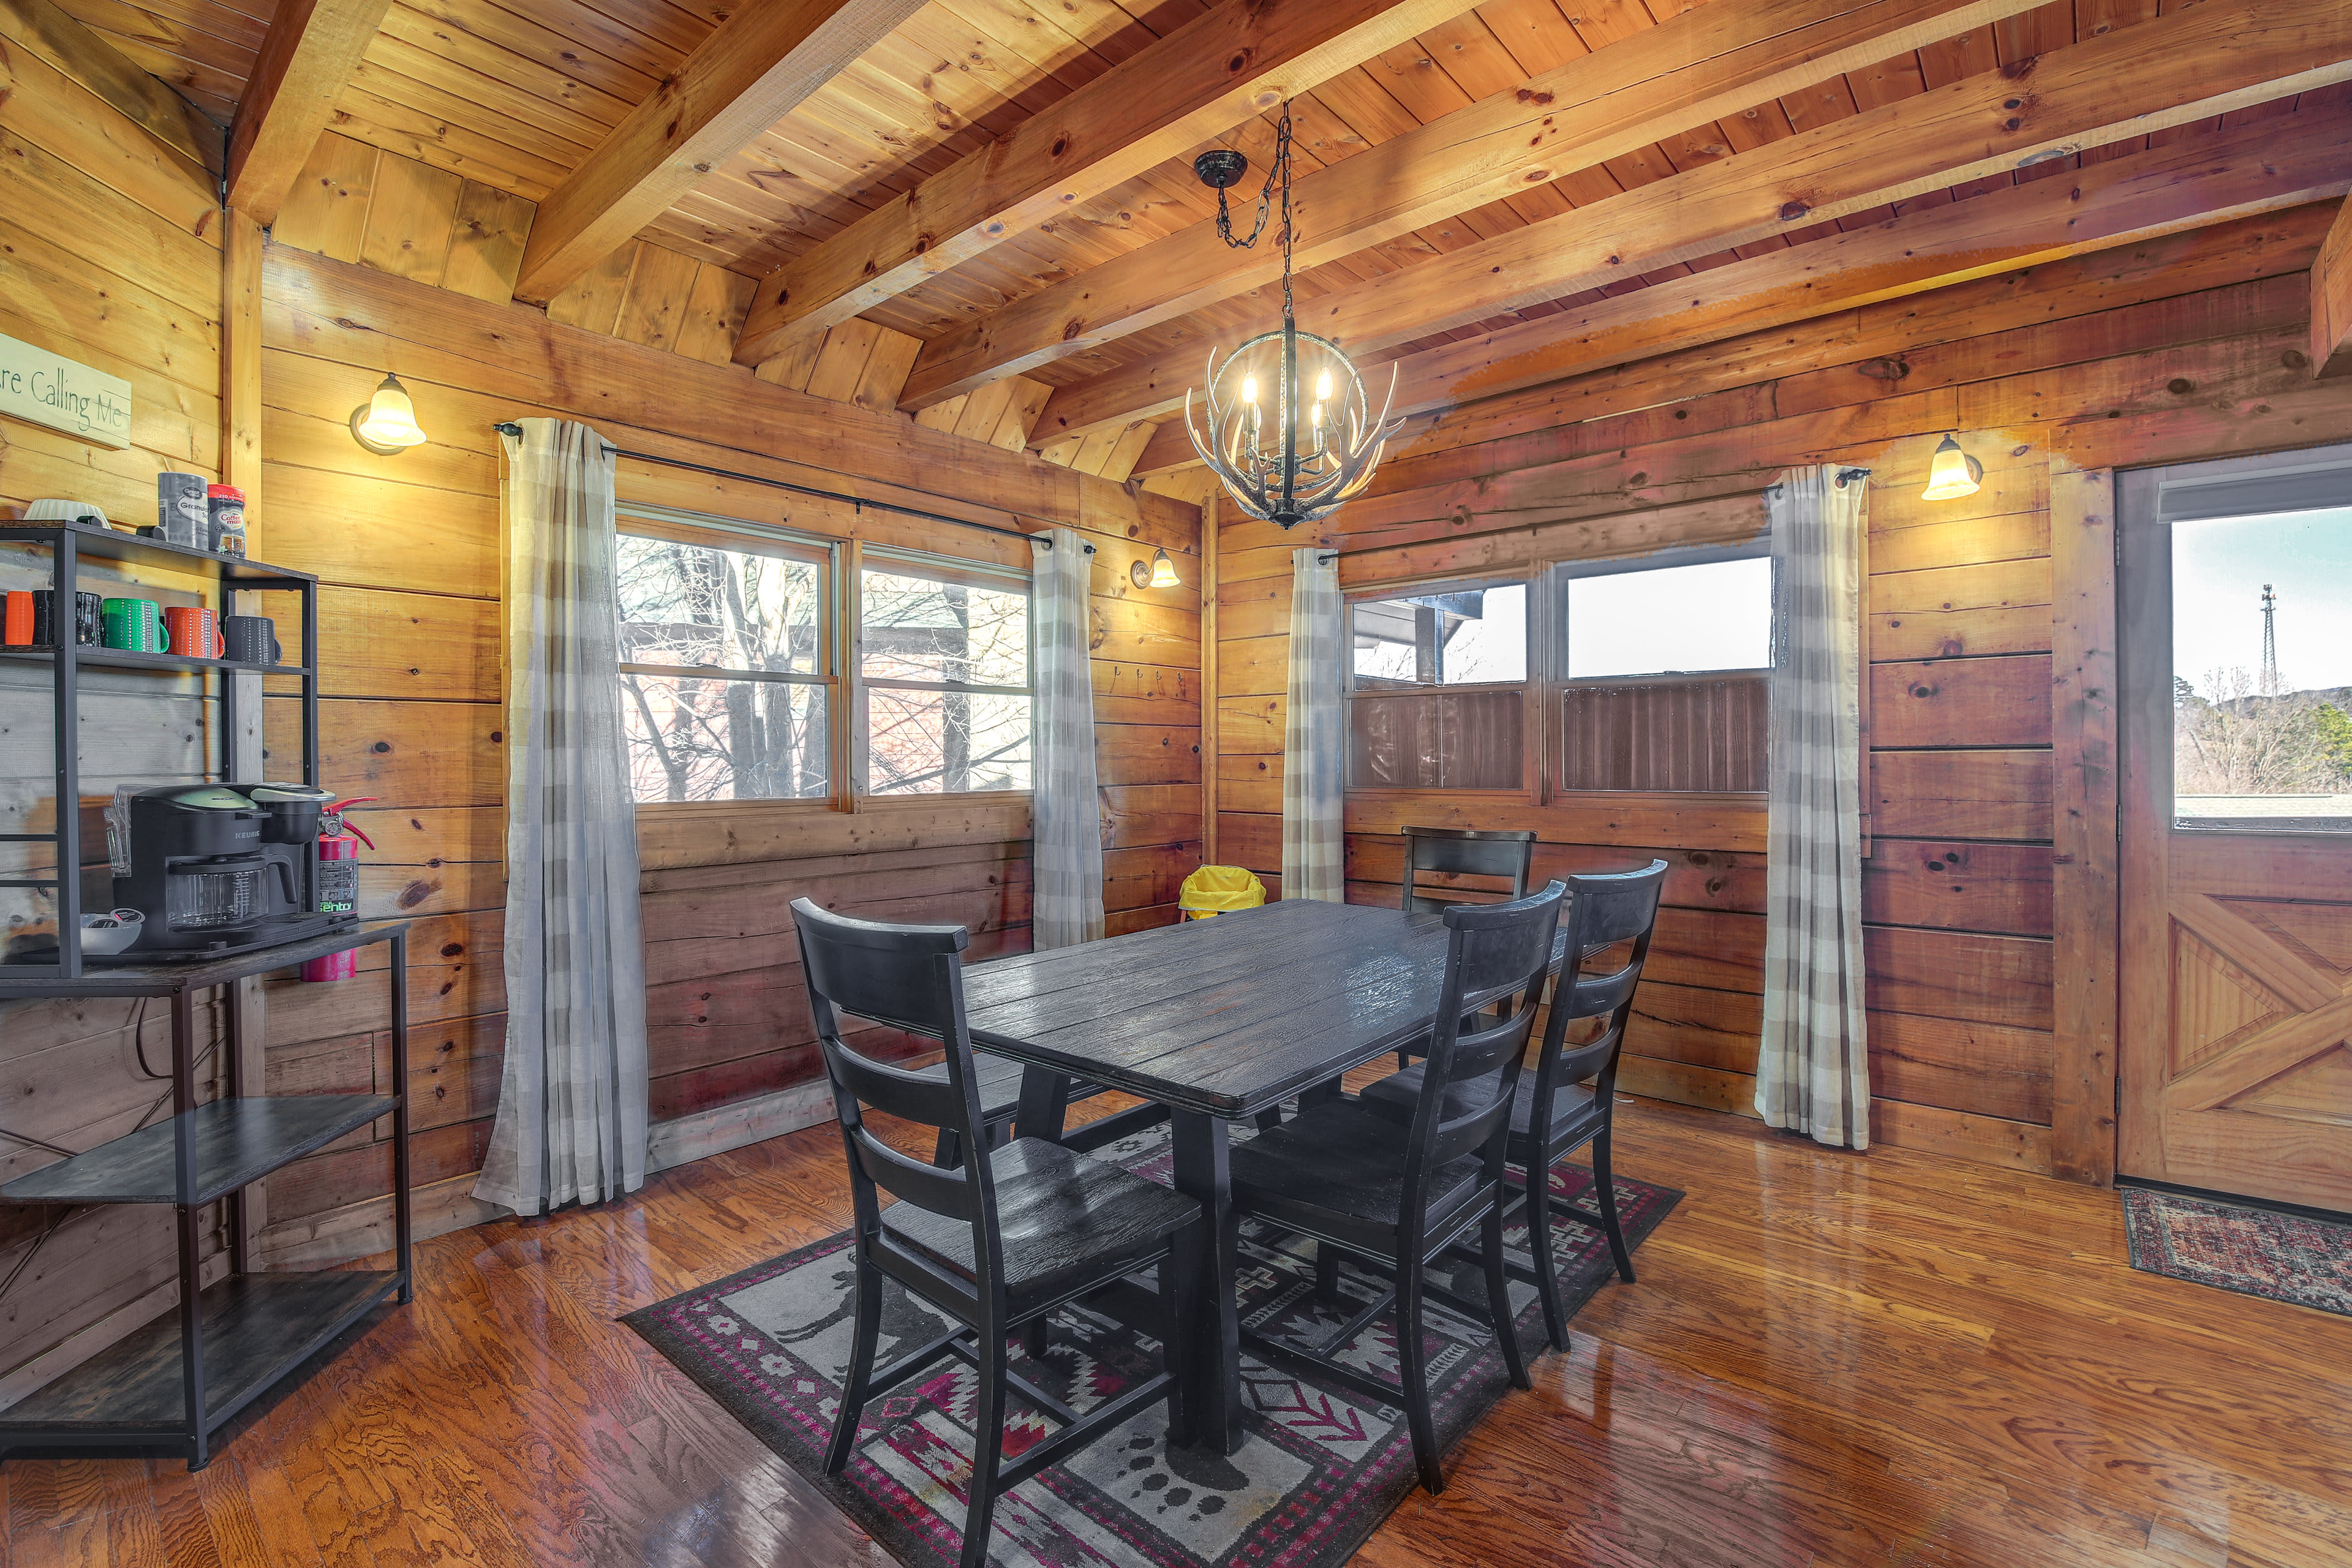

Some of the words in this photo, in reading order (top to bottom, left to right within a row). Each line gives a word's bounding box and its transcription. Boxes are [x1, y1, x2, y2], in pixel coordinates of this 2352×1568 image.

[0, 369, 21, 393] re
[31, 368, 90, 431] Calling
[97, 394, 122, 427] Me
[235, 830, 260, 839] KEURIG
